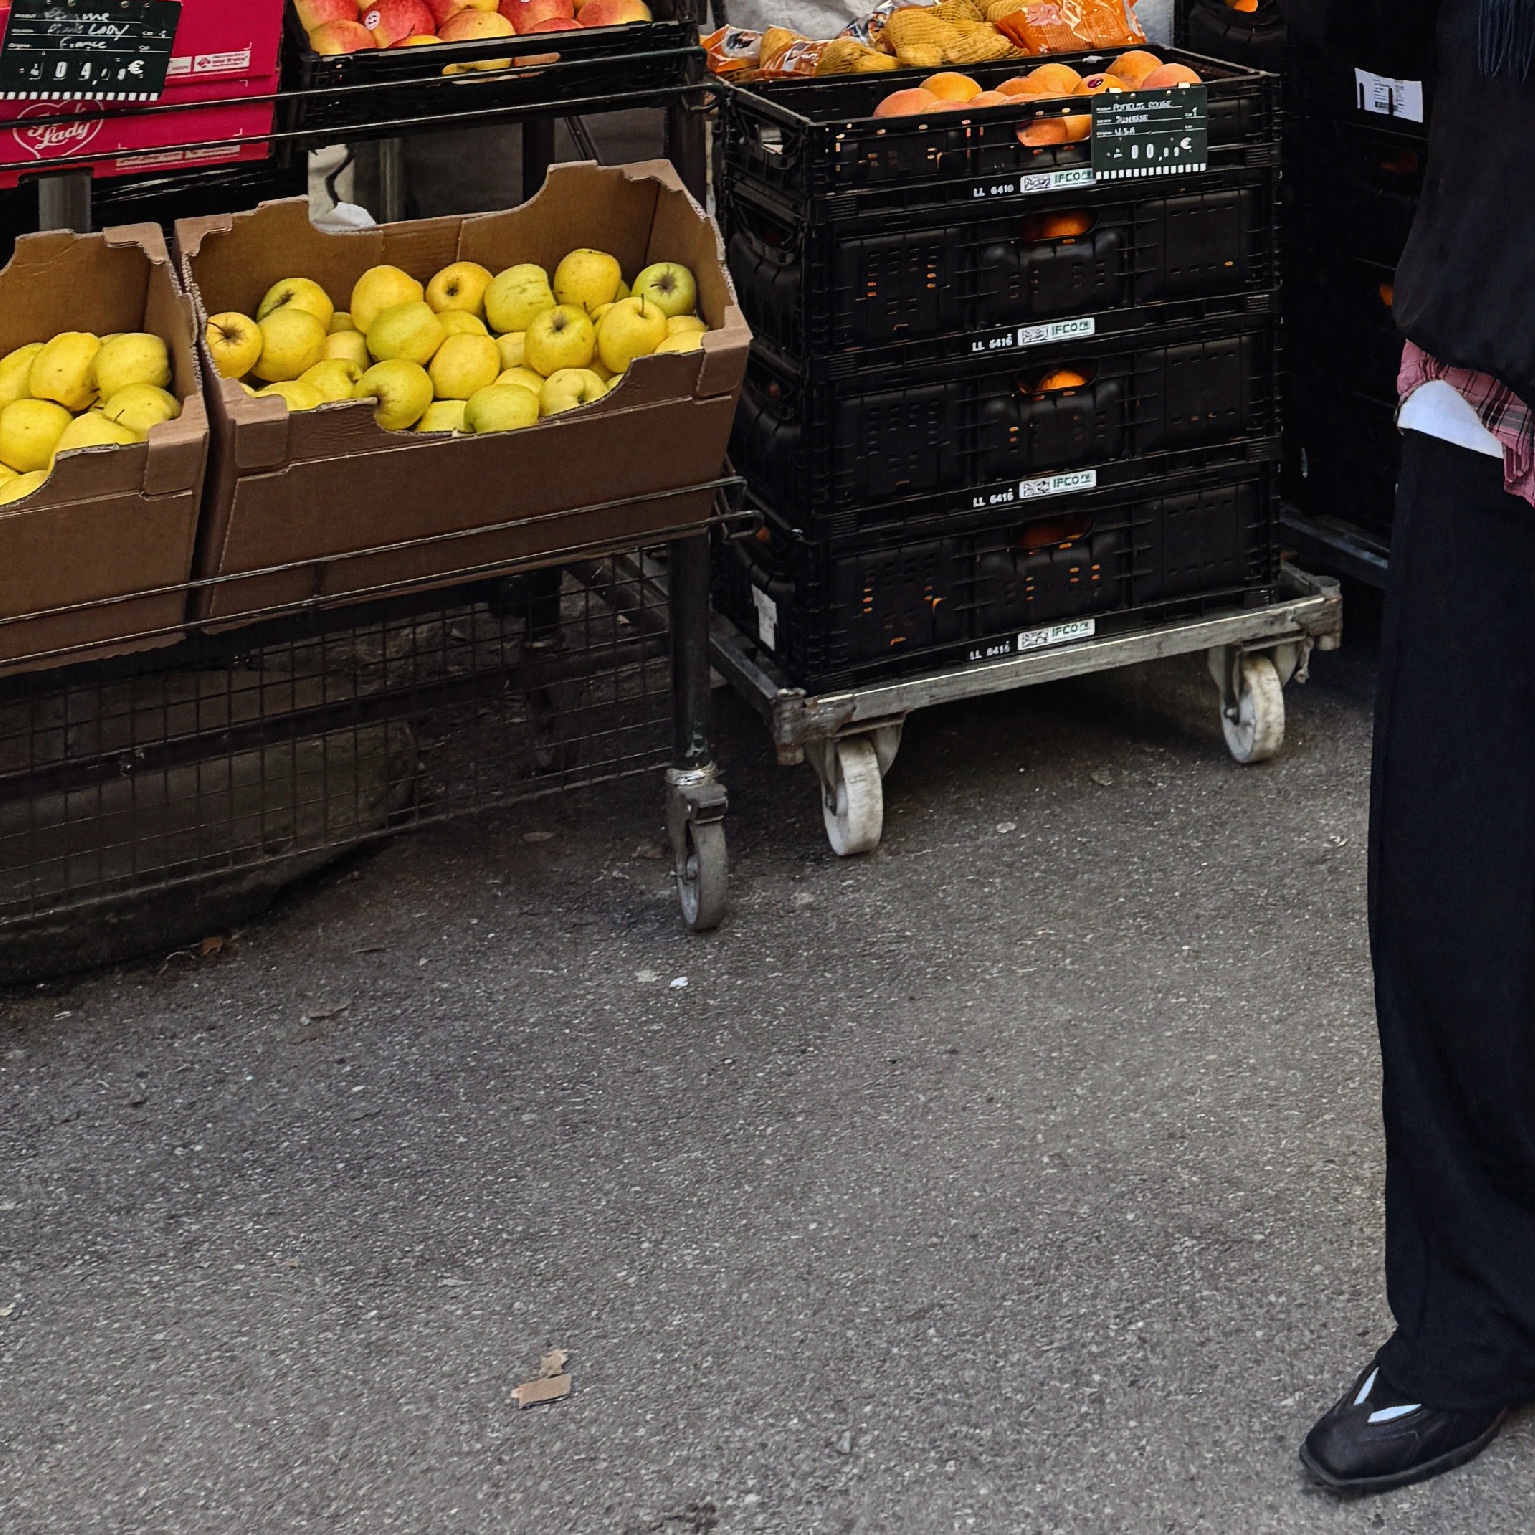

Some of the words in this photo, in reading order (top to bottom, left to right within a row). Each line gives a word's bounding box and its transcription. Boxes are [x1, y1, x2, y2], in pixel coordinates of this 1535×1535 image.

[35, 121, 90, 149] Lady
[1055, 172, 1080, 184] IFCO
[1052, 322, 1078, 335] IFCO
[1053, 475, 1079, 489] IFCO
[1052, 624, 1078, 637] IFCO
